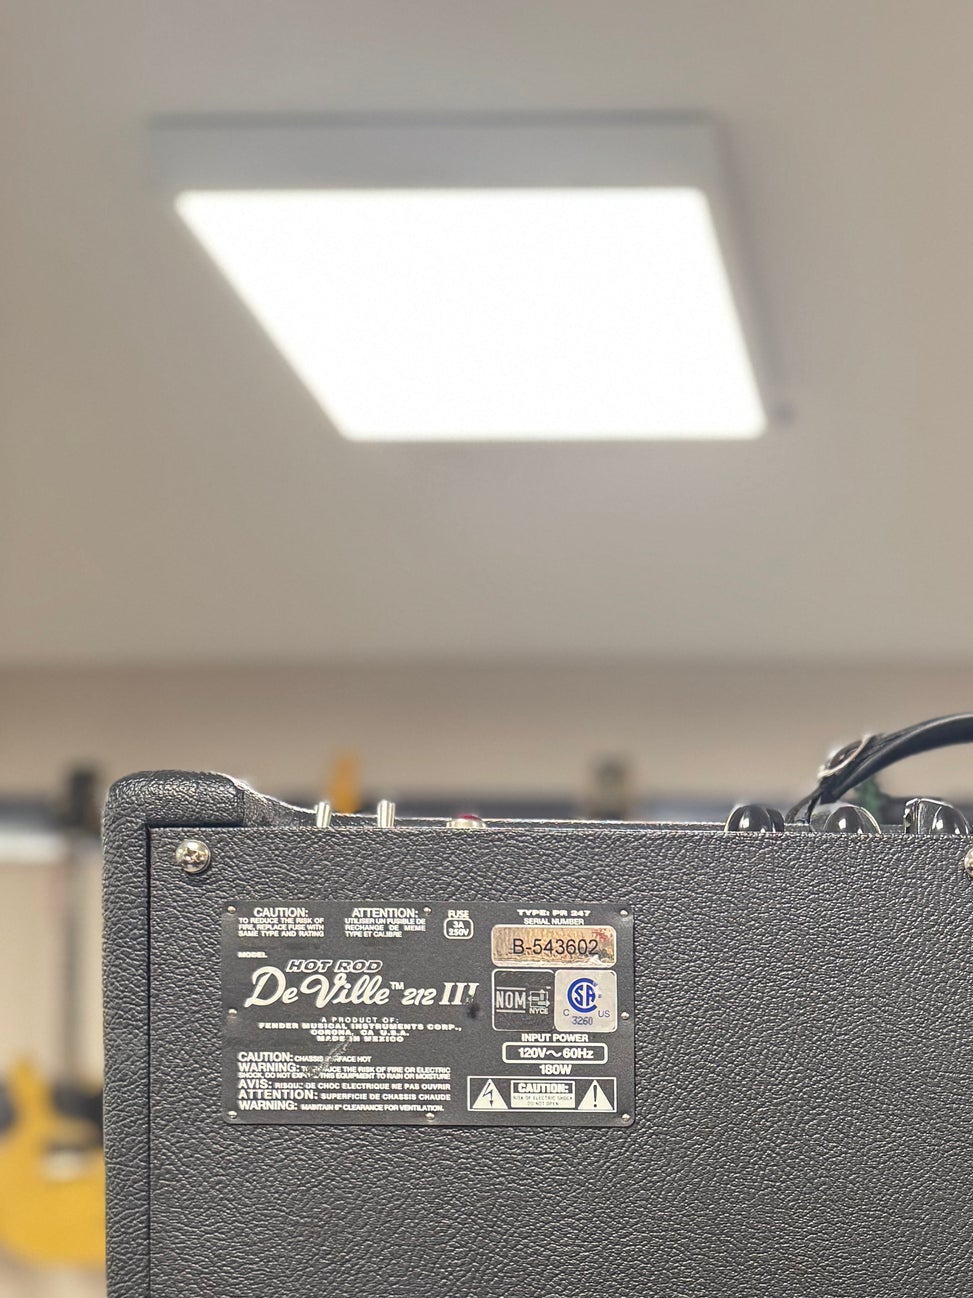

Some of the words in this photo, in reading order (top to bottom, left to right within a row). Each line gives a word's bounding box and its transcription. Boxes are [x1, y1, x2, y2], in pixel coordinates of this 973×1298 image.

[253, 907, 309, 918] CAUTION:
[352, 908, 419, 918] ATTENTION:
[448, 910, 470, 919] FUSE
[453, 921, 465, 929] 3A
[512, 938, 599, 955] B-543602
[286, 959, 333, 973] HOT
[334, 960, 383, 973] ROD
[401, 988, 437, 1006] 212
[496, 991, 526, 1009] NOM
[563, 1009, 570, 1017] C
[598, 1010, 611, 1018] US
[572, 1016, 594, 1026] 3260
[427, 1024, 462, 1032] CORP.,
[522, 1034, 551, 1042] INPUT
[553, 1034, 589, 1043] POWER
[238, 1052, 293, 1062] CAUTION:
[238, 1062, 300, 1072] WARNING:
[539, 1064, 572, 1075] 180W
[238, 1079, 273, 1089] AVIS:
[518, 1083, 570, 1093] CAUTION:
[238, 1089, 319, 1100] ATTENTION:
[238, 1100, 298, 1111] WARNING:
